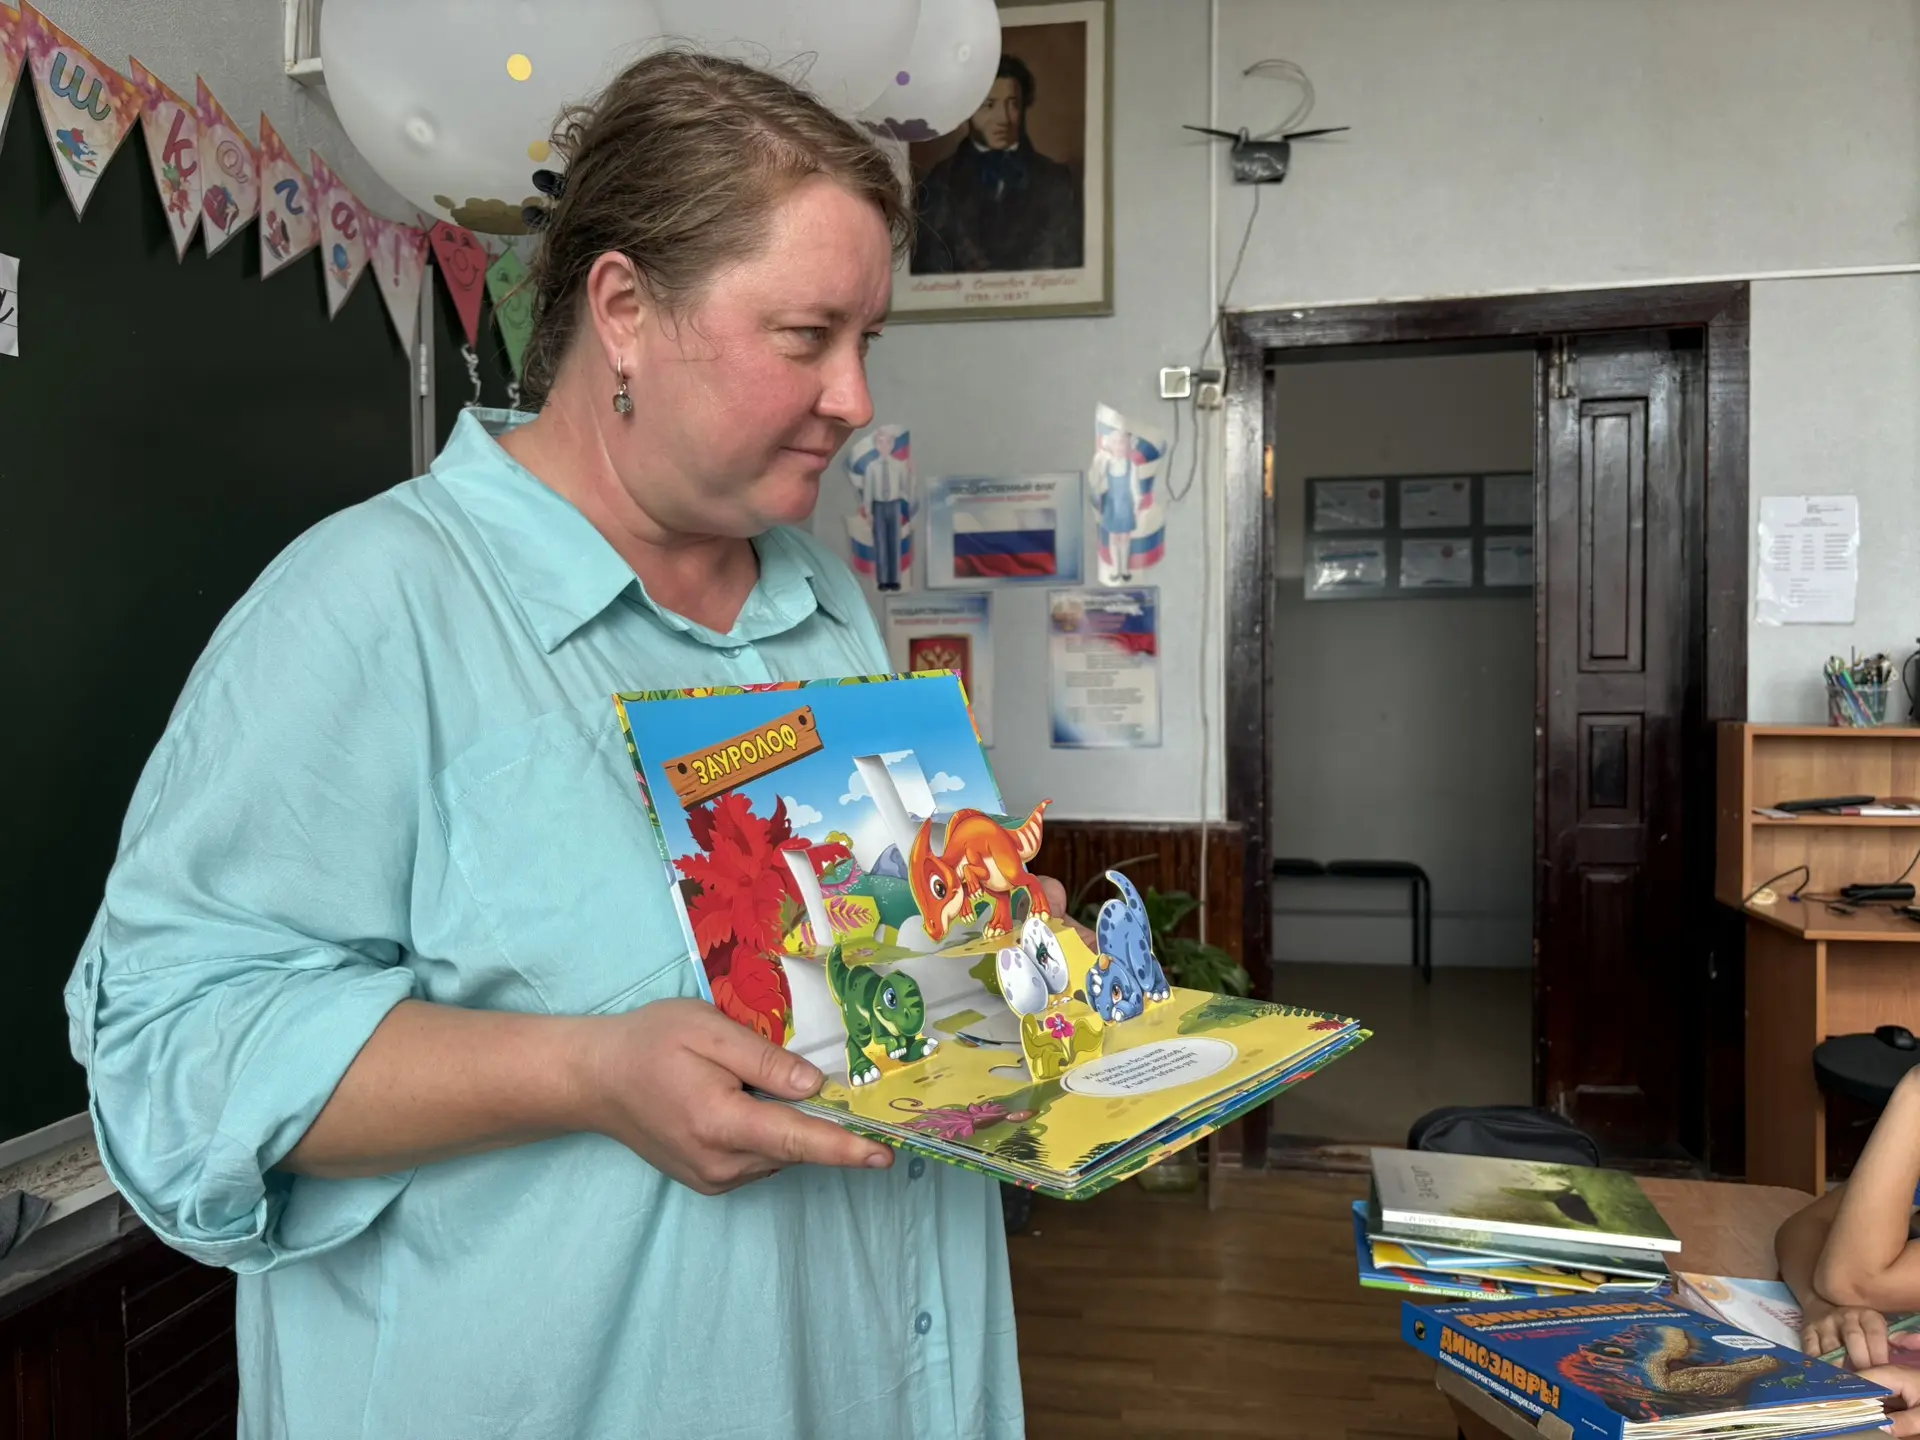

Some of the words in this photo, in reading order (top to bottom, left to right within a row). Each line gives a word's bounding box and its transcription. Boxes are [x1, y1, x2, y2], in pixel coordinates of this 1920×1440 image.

[691, 723, 798, 785] ЗАУРОЛОФ
[1455, 1301, 1675, 1329] ДИНОЗАВРЫ
[1439, 1326, 1560, 1409] ДИНОЗАВРЫ
[1439, 1350, 1466, 1371] БОЛЬШАЯ
[1464, 1365, 1510, 1398] ИНТЕРАКТИВНАЯ
[1509, 1388, 1545, 1416] ЭНЦИКЛОПЕ
